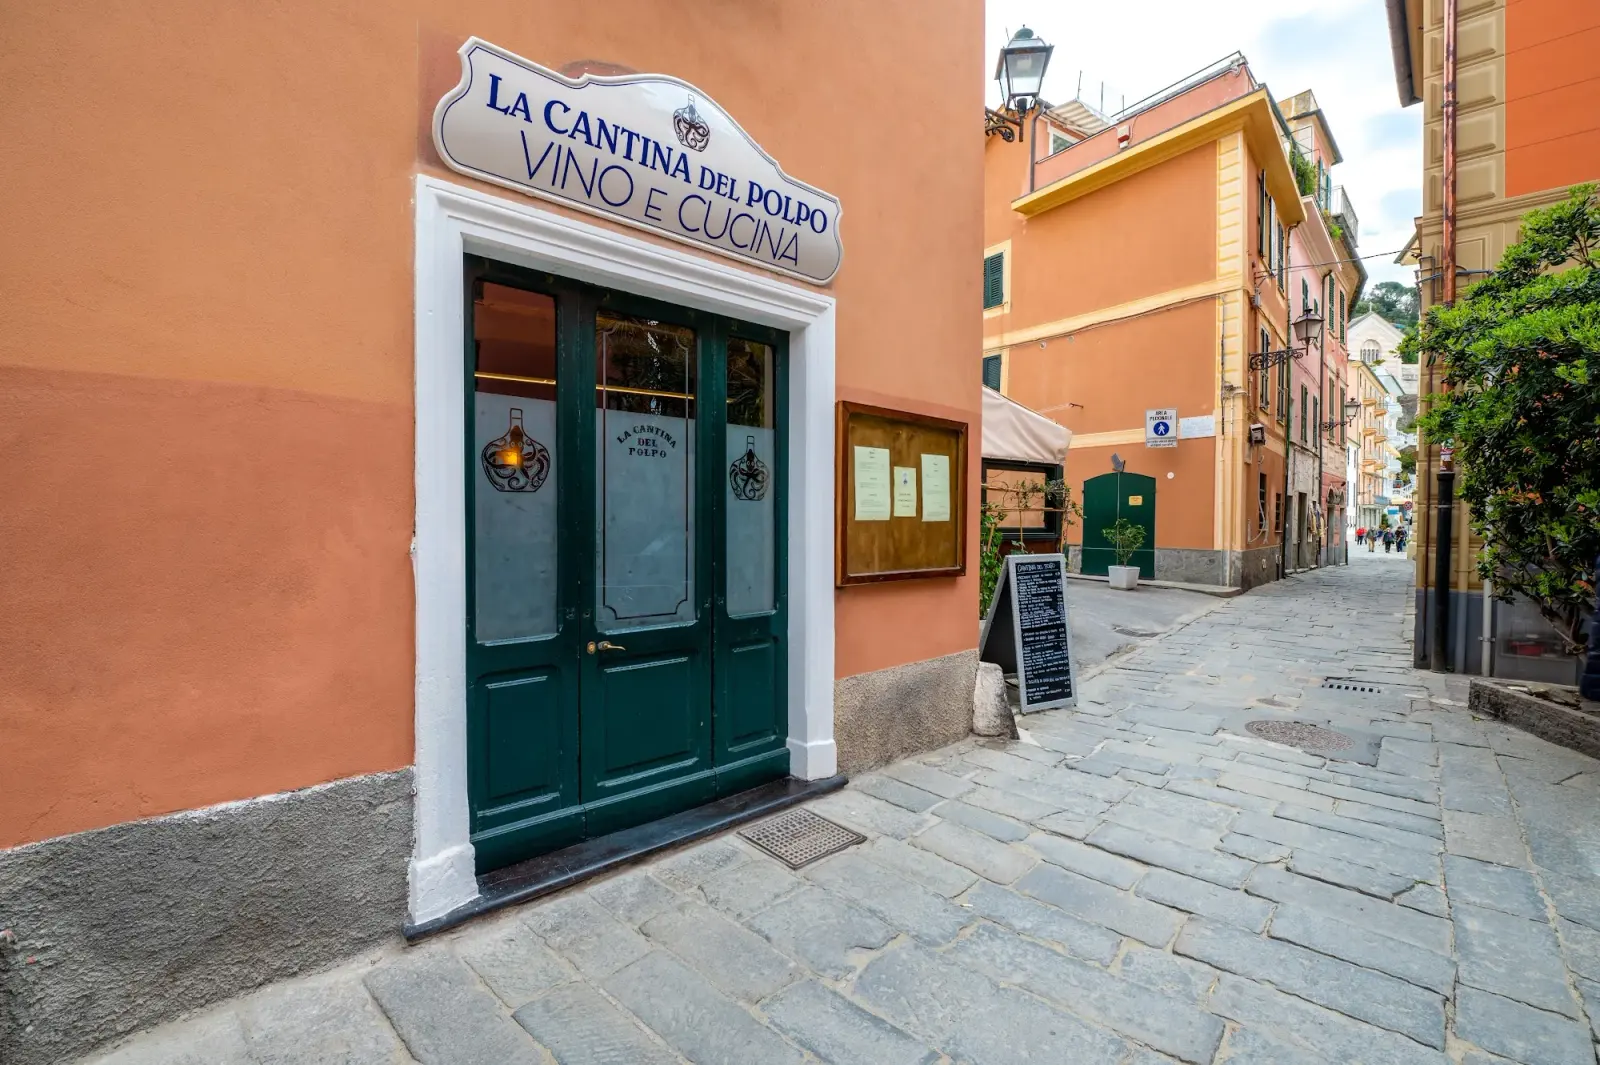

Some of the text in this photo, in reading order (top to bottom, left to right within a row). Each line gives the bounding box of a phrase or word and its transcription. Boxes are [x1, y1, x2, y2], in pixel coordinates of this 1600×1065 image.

[486, 73, 828, 234] LA CANTINA DEL POLPO
[520, 130, 799, 267] VINO E CUCINA
[616, 424, 676, 448] LA CANTINA
[638, 438, 658, 447] DEL
[628, 448, 666, 458] POLPO
